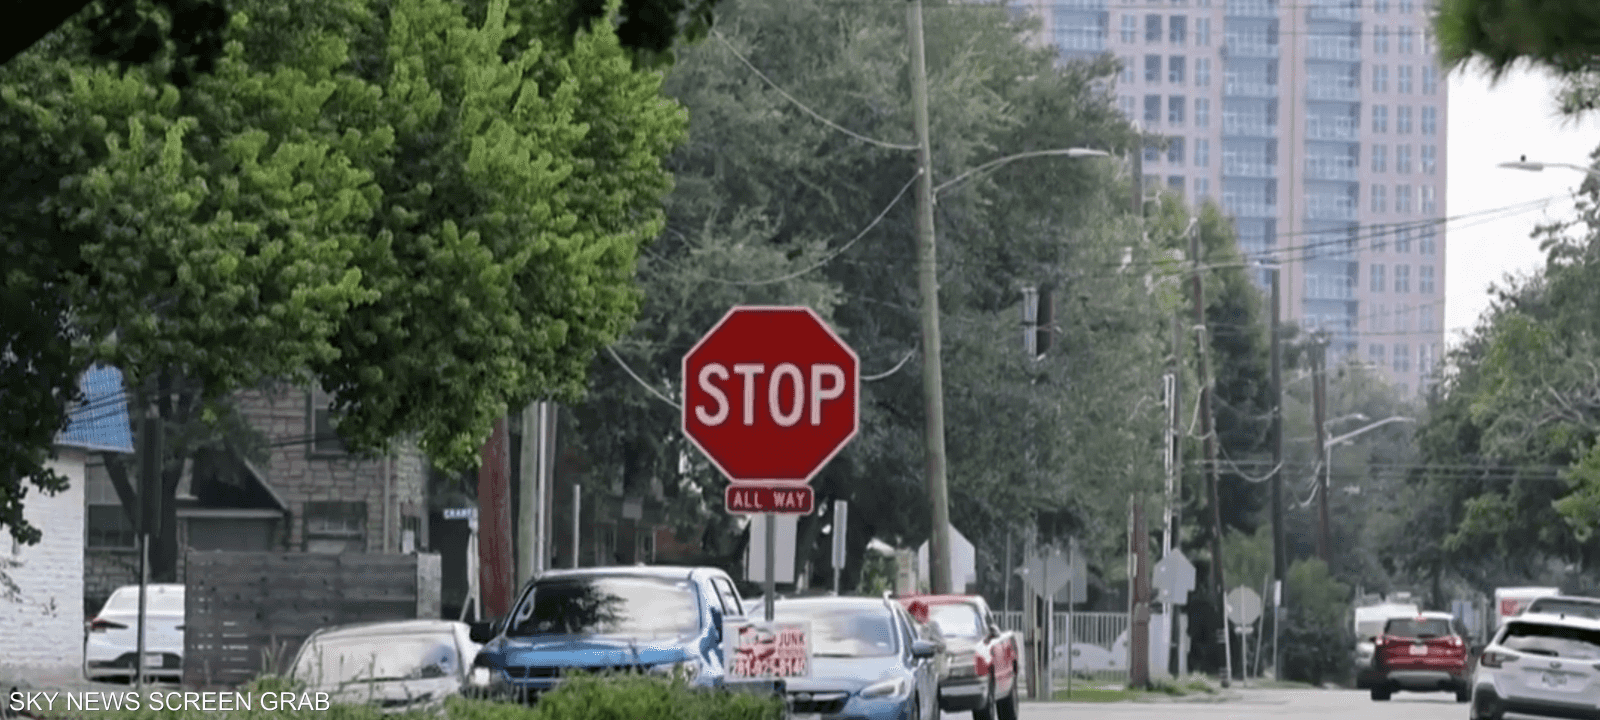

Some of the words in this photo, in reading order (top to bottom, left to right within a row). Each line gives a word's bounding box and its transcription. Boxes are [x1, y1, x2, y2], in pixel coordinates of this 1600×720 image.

[695, 362, 846, 427] STOP
[733, 491, 763, 508] ALL
[773, 491, 806, 508] WAY
[780, 632, 805, 647] JUNK
